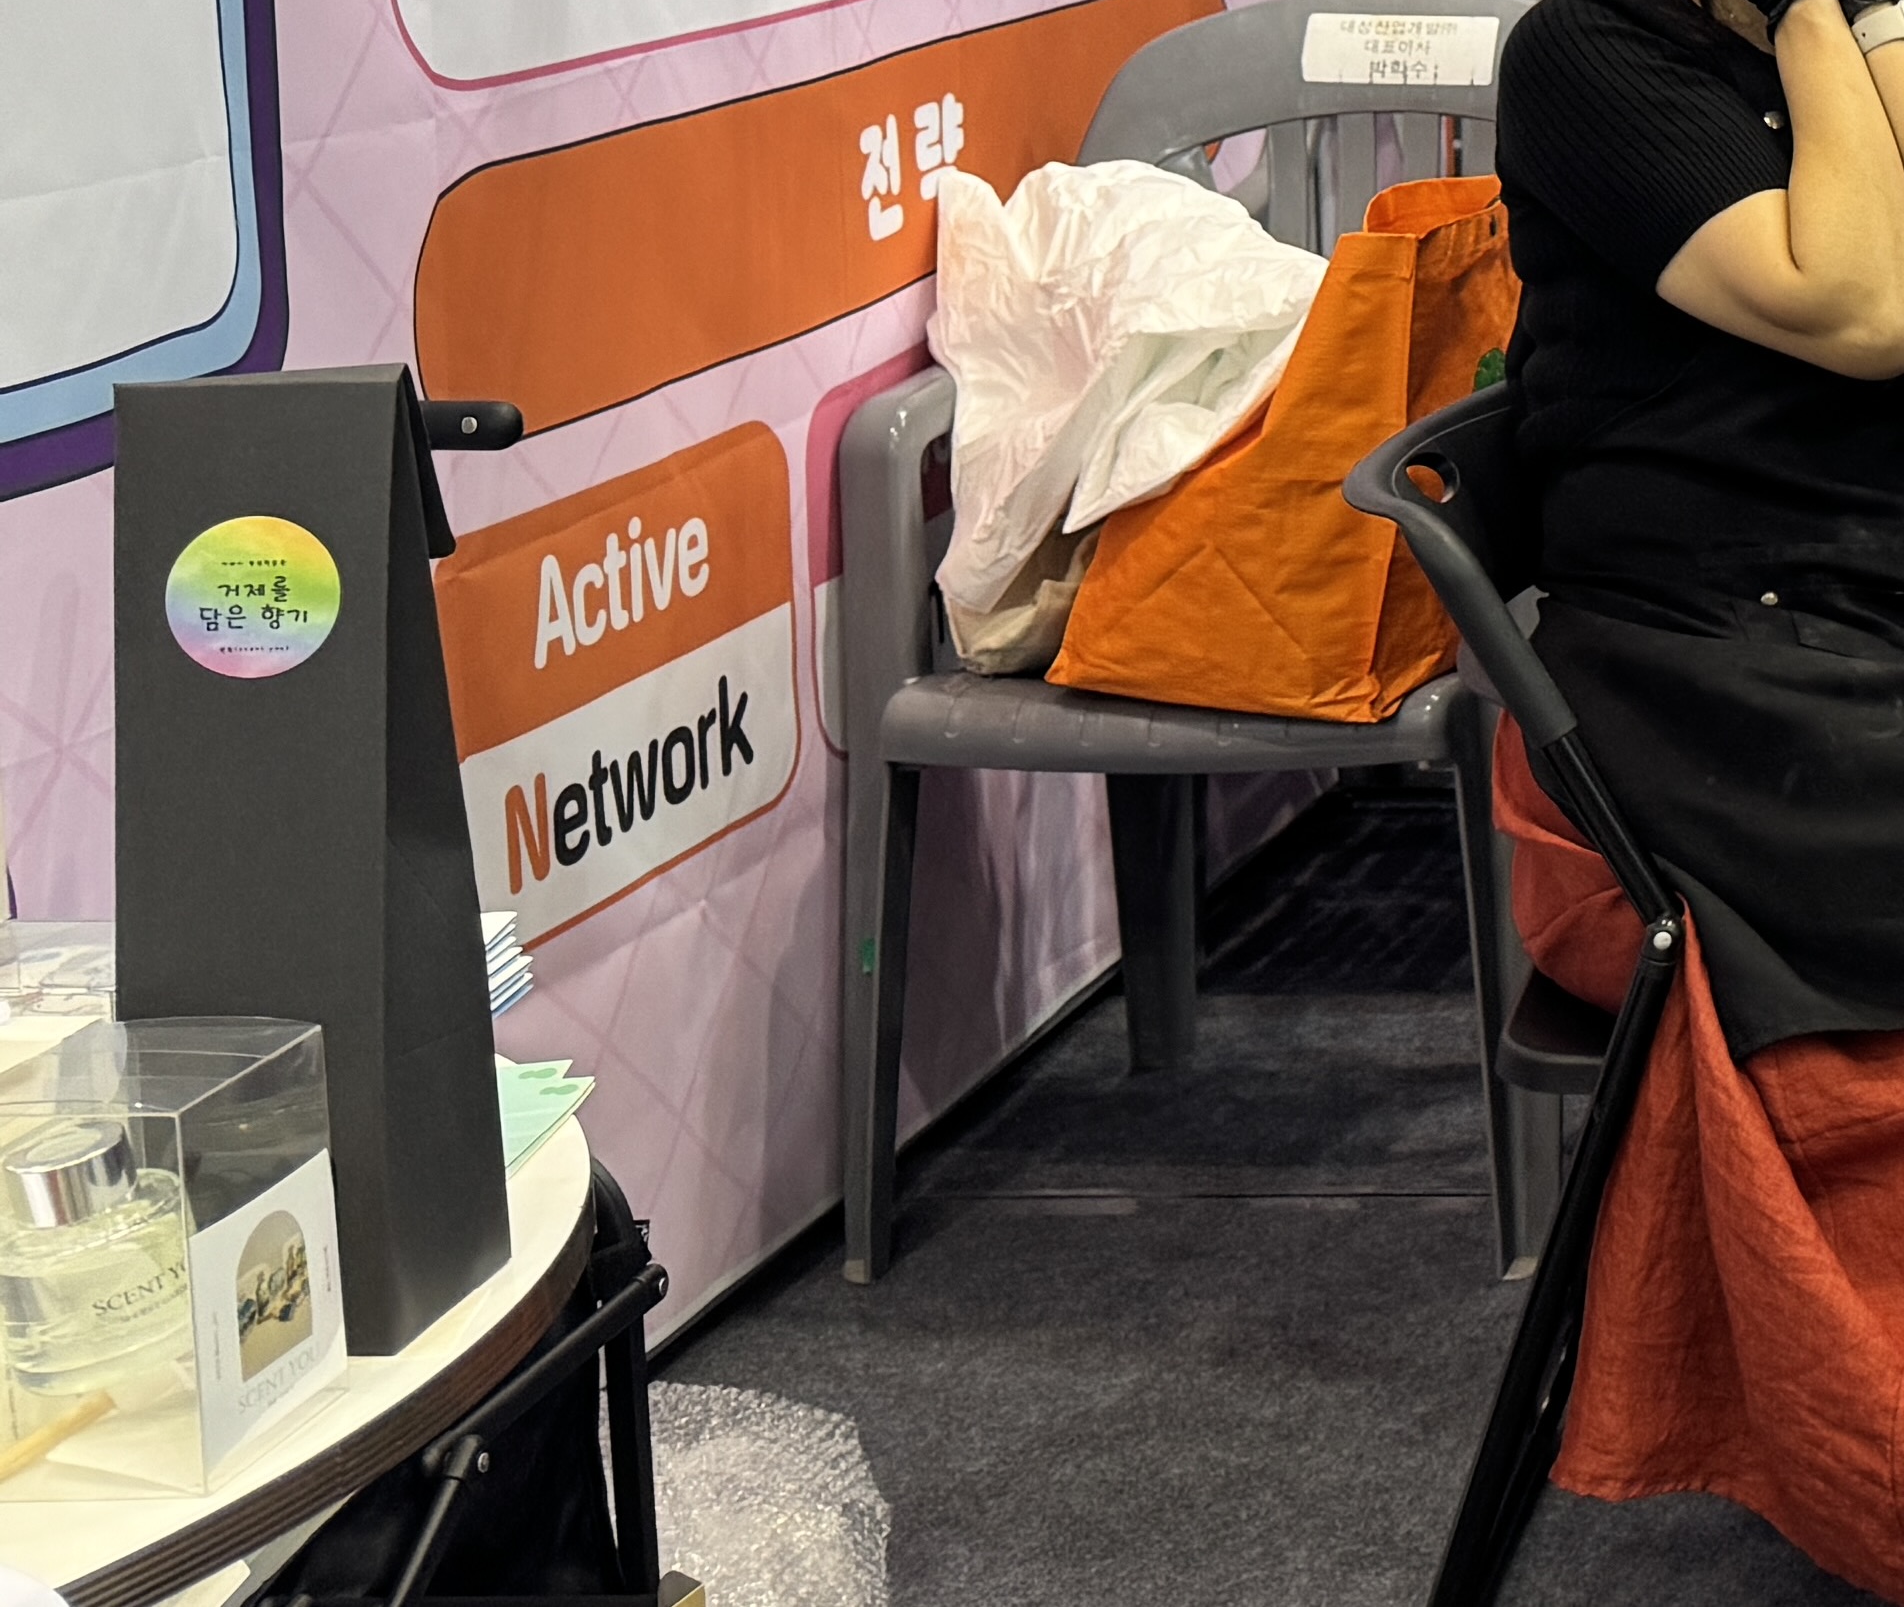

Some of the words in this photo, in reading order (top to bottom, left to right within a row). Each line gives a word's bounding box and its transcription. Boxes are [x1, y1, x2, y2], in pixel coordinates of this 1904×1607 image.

[860, 92, 965, 242] 전략
[199, 604, 247, 632] 담은
[261, 604, 308, 630] 향기
[217, 575, 291, 603] 거제를
[532, 513, 711, 673] Active
[504, 674, 756, 895] Network
